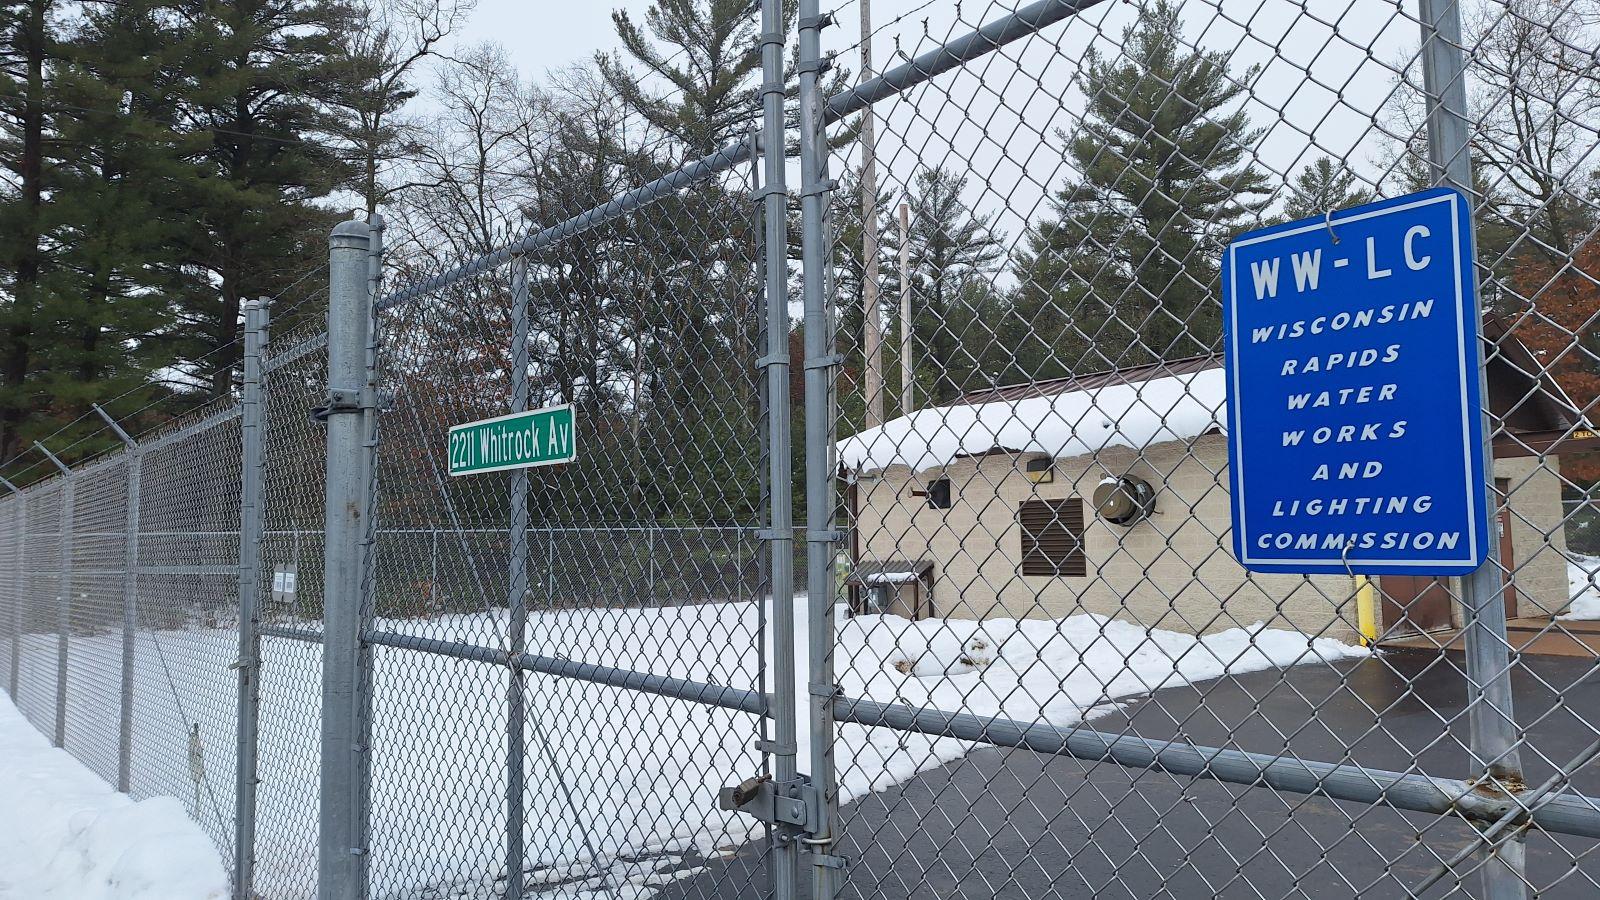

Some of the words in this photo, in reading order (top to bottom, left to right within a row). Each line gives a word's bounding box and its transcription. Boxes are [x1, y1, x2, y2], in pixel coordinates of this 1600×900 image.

[1252, 300, 1434, 344] WISCONSIN
[1281, 345, 1401, 376] RAPIDS
[1287, 384, 1398, 411] WATER
[451, 431, 475, 469] 2211
[479, 420, 541, 465] Whitrock
[548, 416, 569, 456] Av
[1282, 421, 1408, 447] WORKS
[1311, 461, 1383, 481] AND
[1272, 496, 1432, 517] LIGHTING
[1257, 531, 1460, 550] COMMISSION
